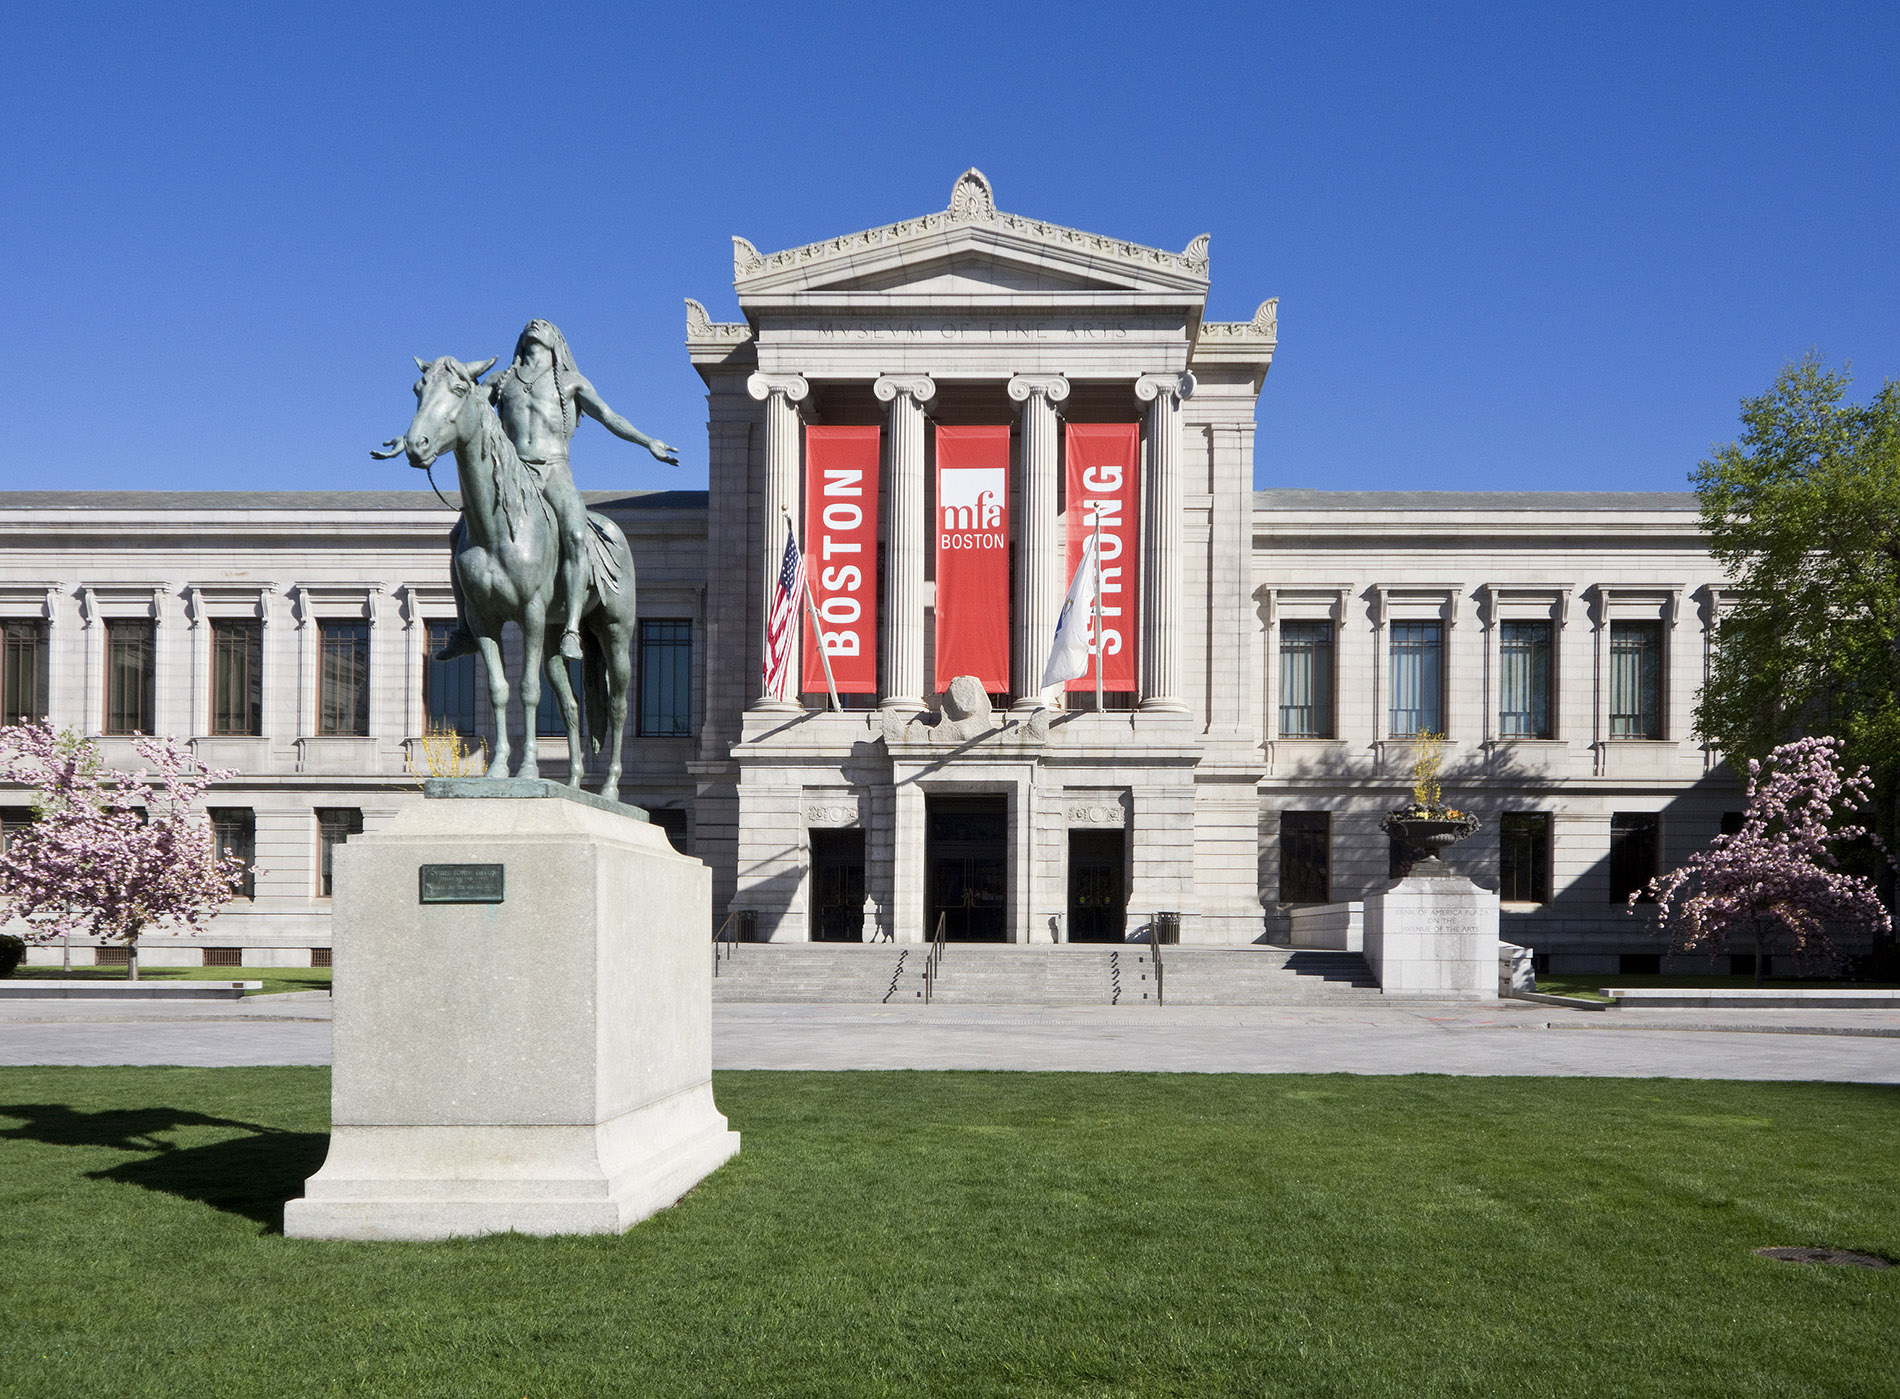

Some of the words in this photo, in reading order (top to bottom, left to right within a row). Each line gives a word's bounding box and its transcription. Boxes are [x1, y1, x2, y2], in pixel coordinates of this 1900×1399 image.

[817, 322, 923, 339] MVSEVM
[940, 322, 970, 339] OF
[988, 322, 1048, 339] FINE
[1064, 322, 1127, 339] ARTS
[940, 490, 1005, 529] mfa
[941, 533, 1004, 549] BOSTON
[822, 469, 863, 657] BOSTON
